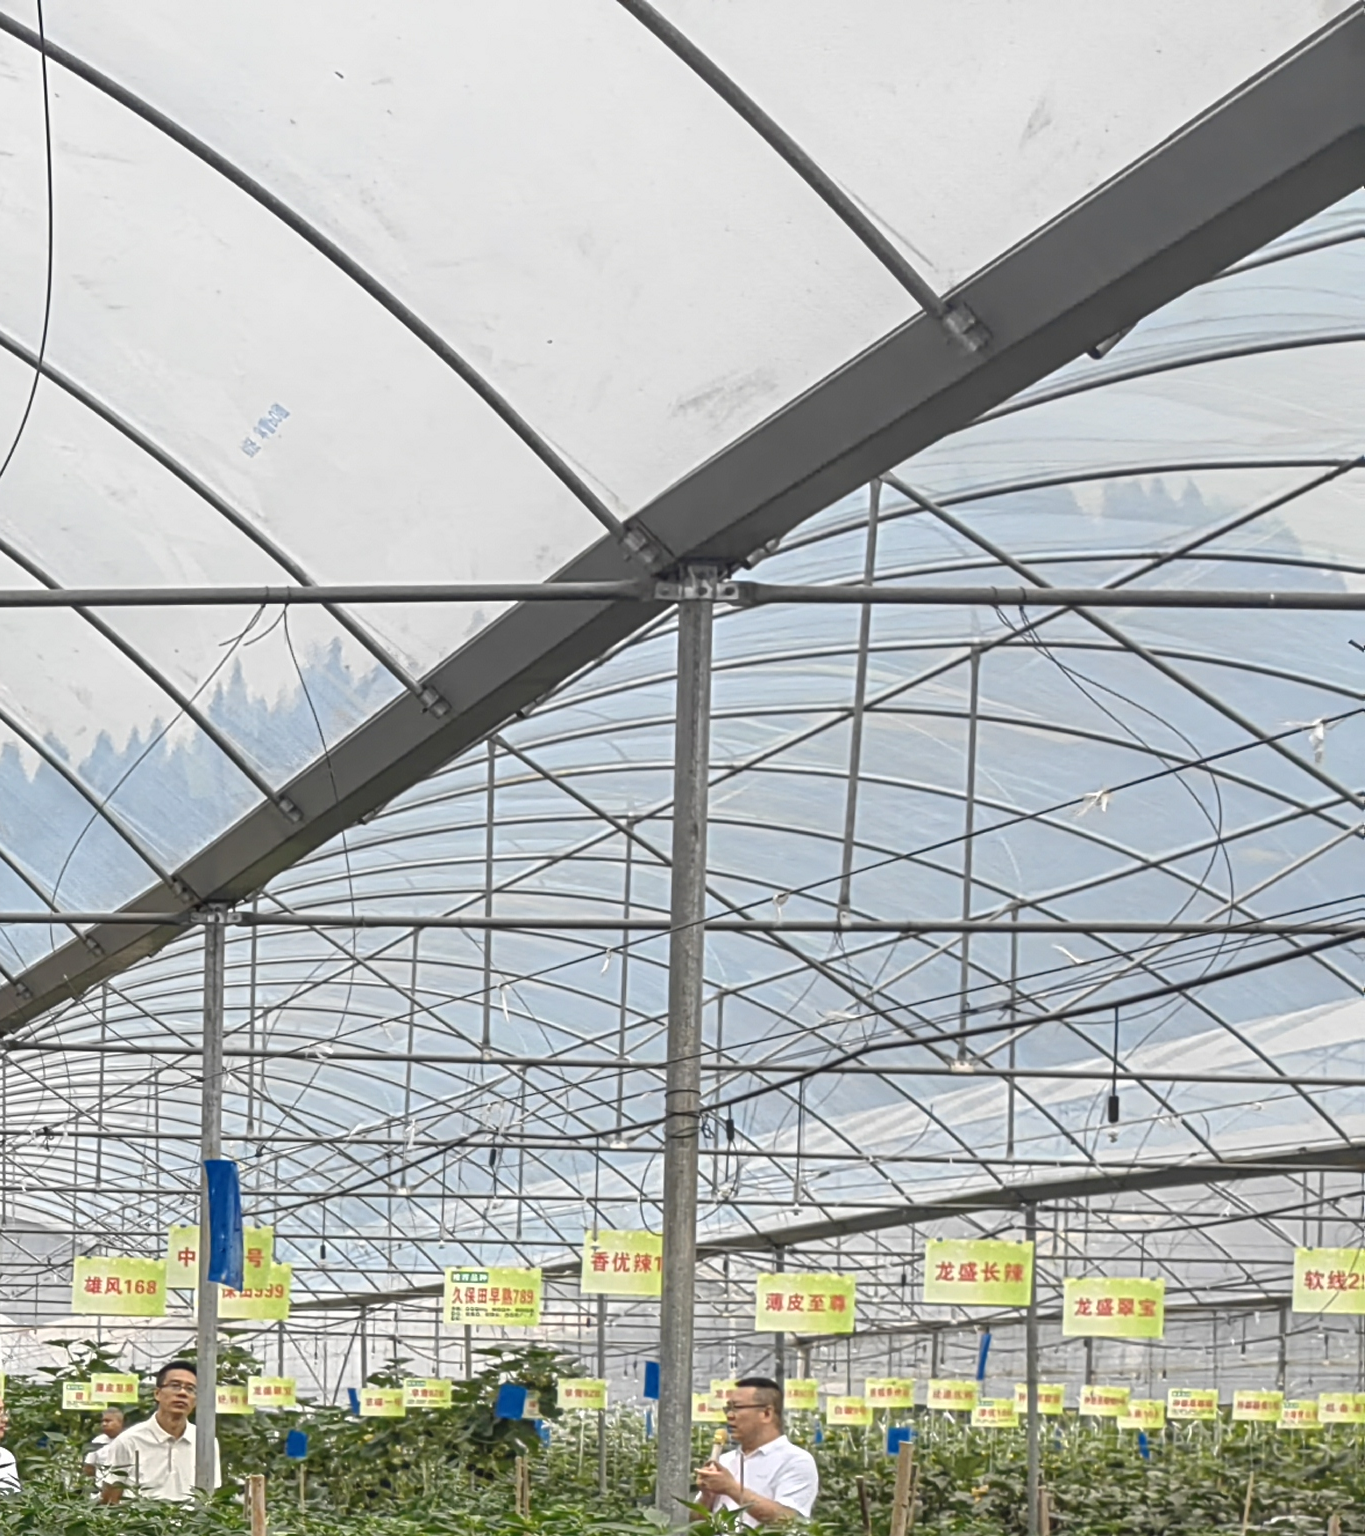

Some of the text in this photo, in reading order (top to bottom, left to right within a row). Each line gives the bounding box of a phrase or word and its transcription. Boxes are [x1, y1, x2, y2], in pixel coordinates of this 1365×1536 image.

[84, 1276, 158, 1296] 雄风168
[1304, 1269, 1365, 1291] 软线2
[451, 1286, 536, 1306] 久保田早熟789
[765, 1292, 848, 1314] 薄皮至尊
[1074, 1297, 1157, 1319] 龙盛翠宝
